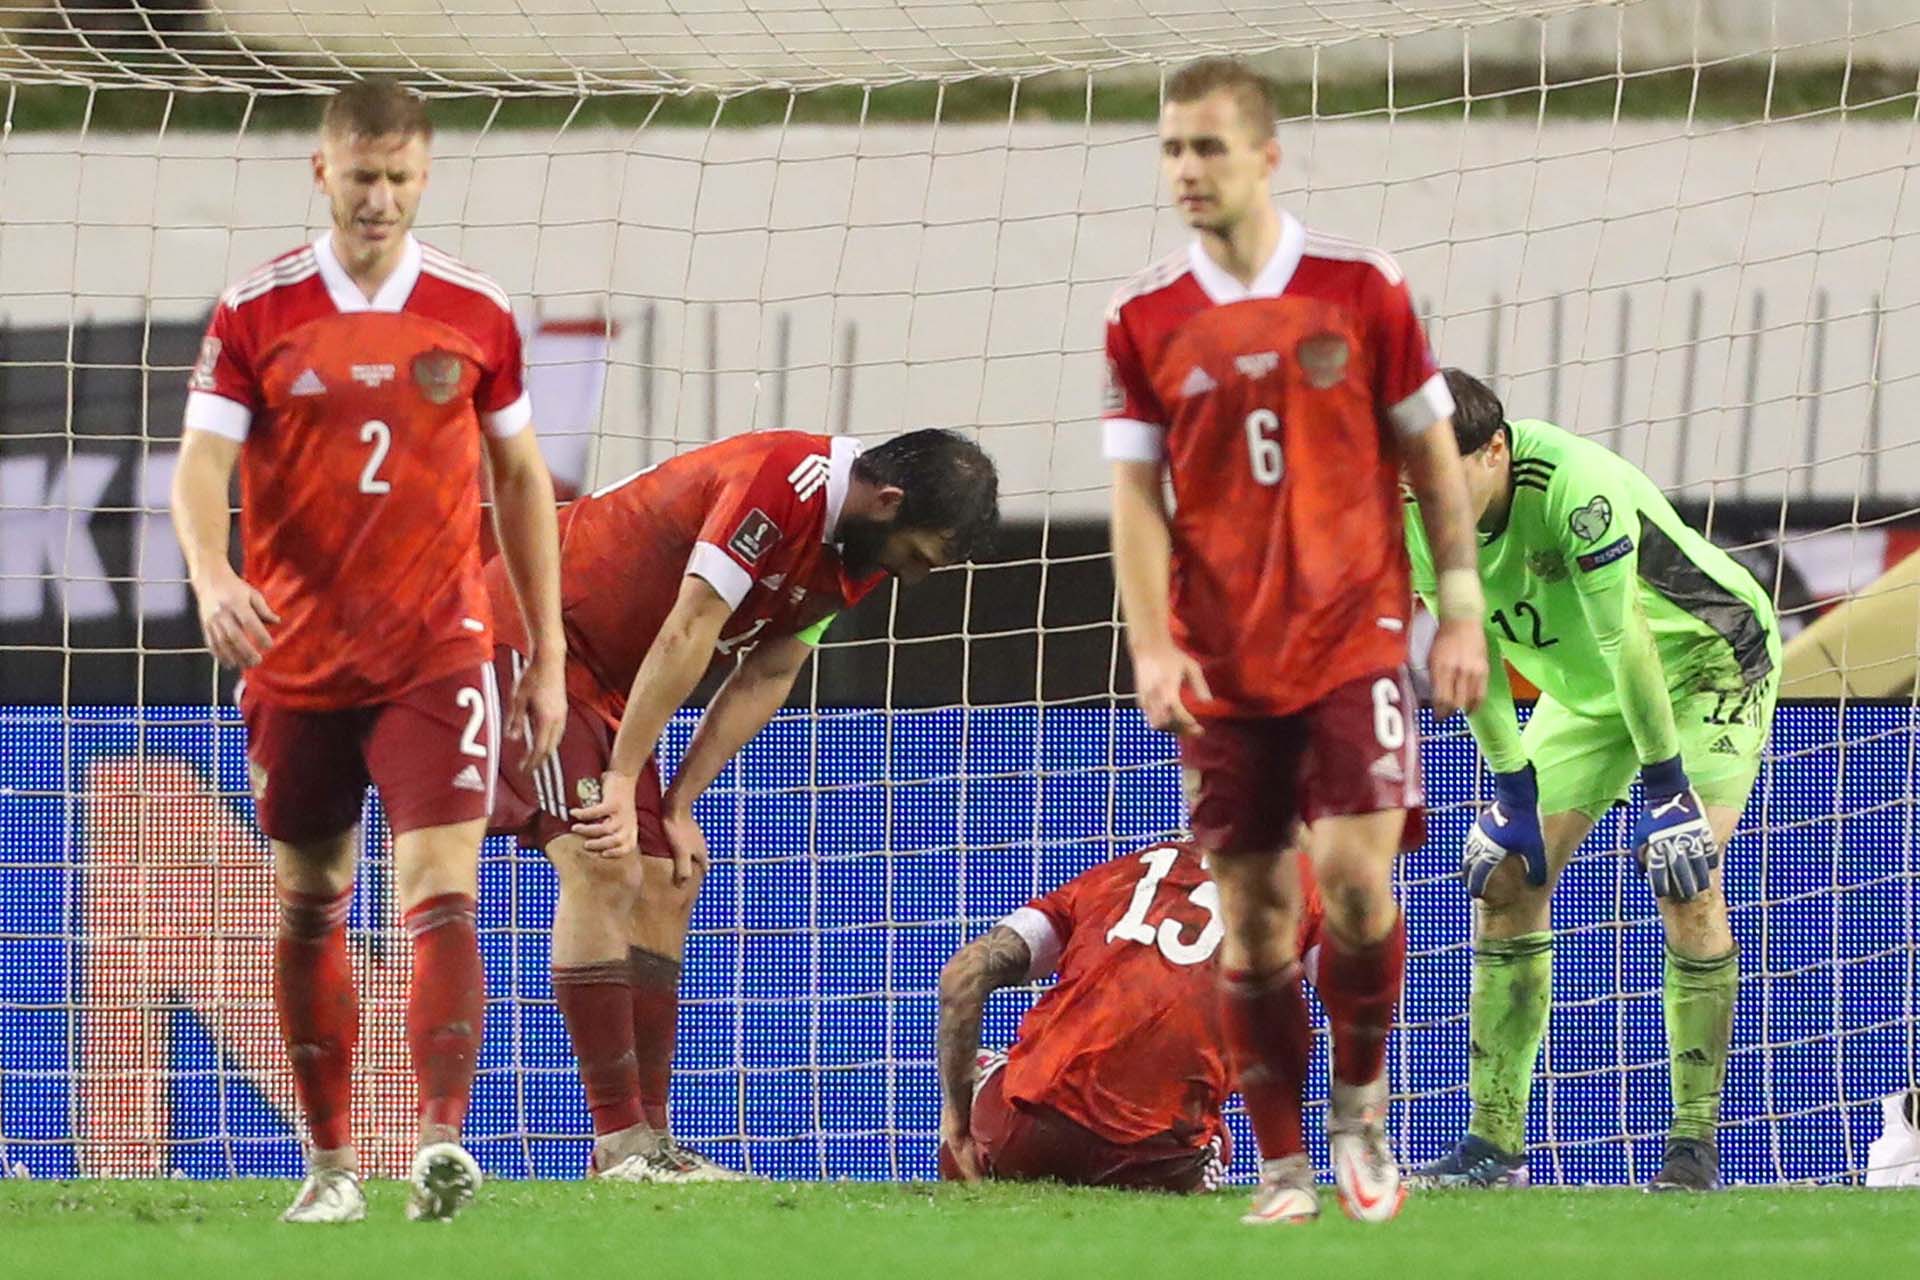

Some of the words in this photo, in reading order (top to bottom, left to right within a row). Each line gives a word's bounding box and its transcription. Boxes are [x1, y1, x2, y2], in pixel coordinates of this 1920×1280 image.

[360, 420, 391, 493] 2
[1245, 408, 1284, 485] 6
[1491, 601, 1559, 648] 12
[456, 687, 487, 757] 2
[1371, 677, 1405, 750] 6
